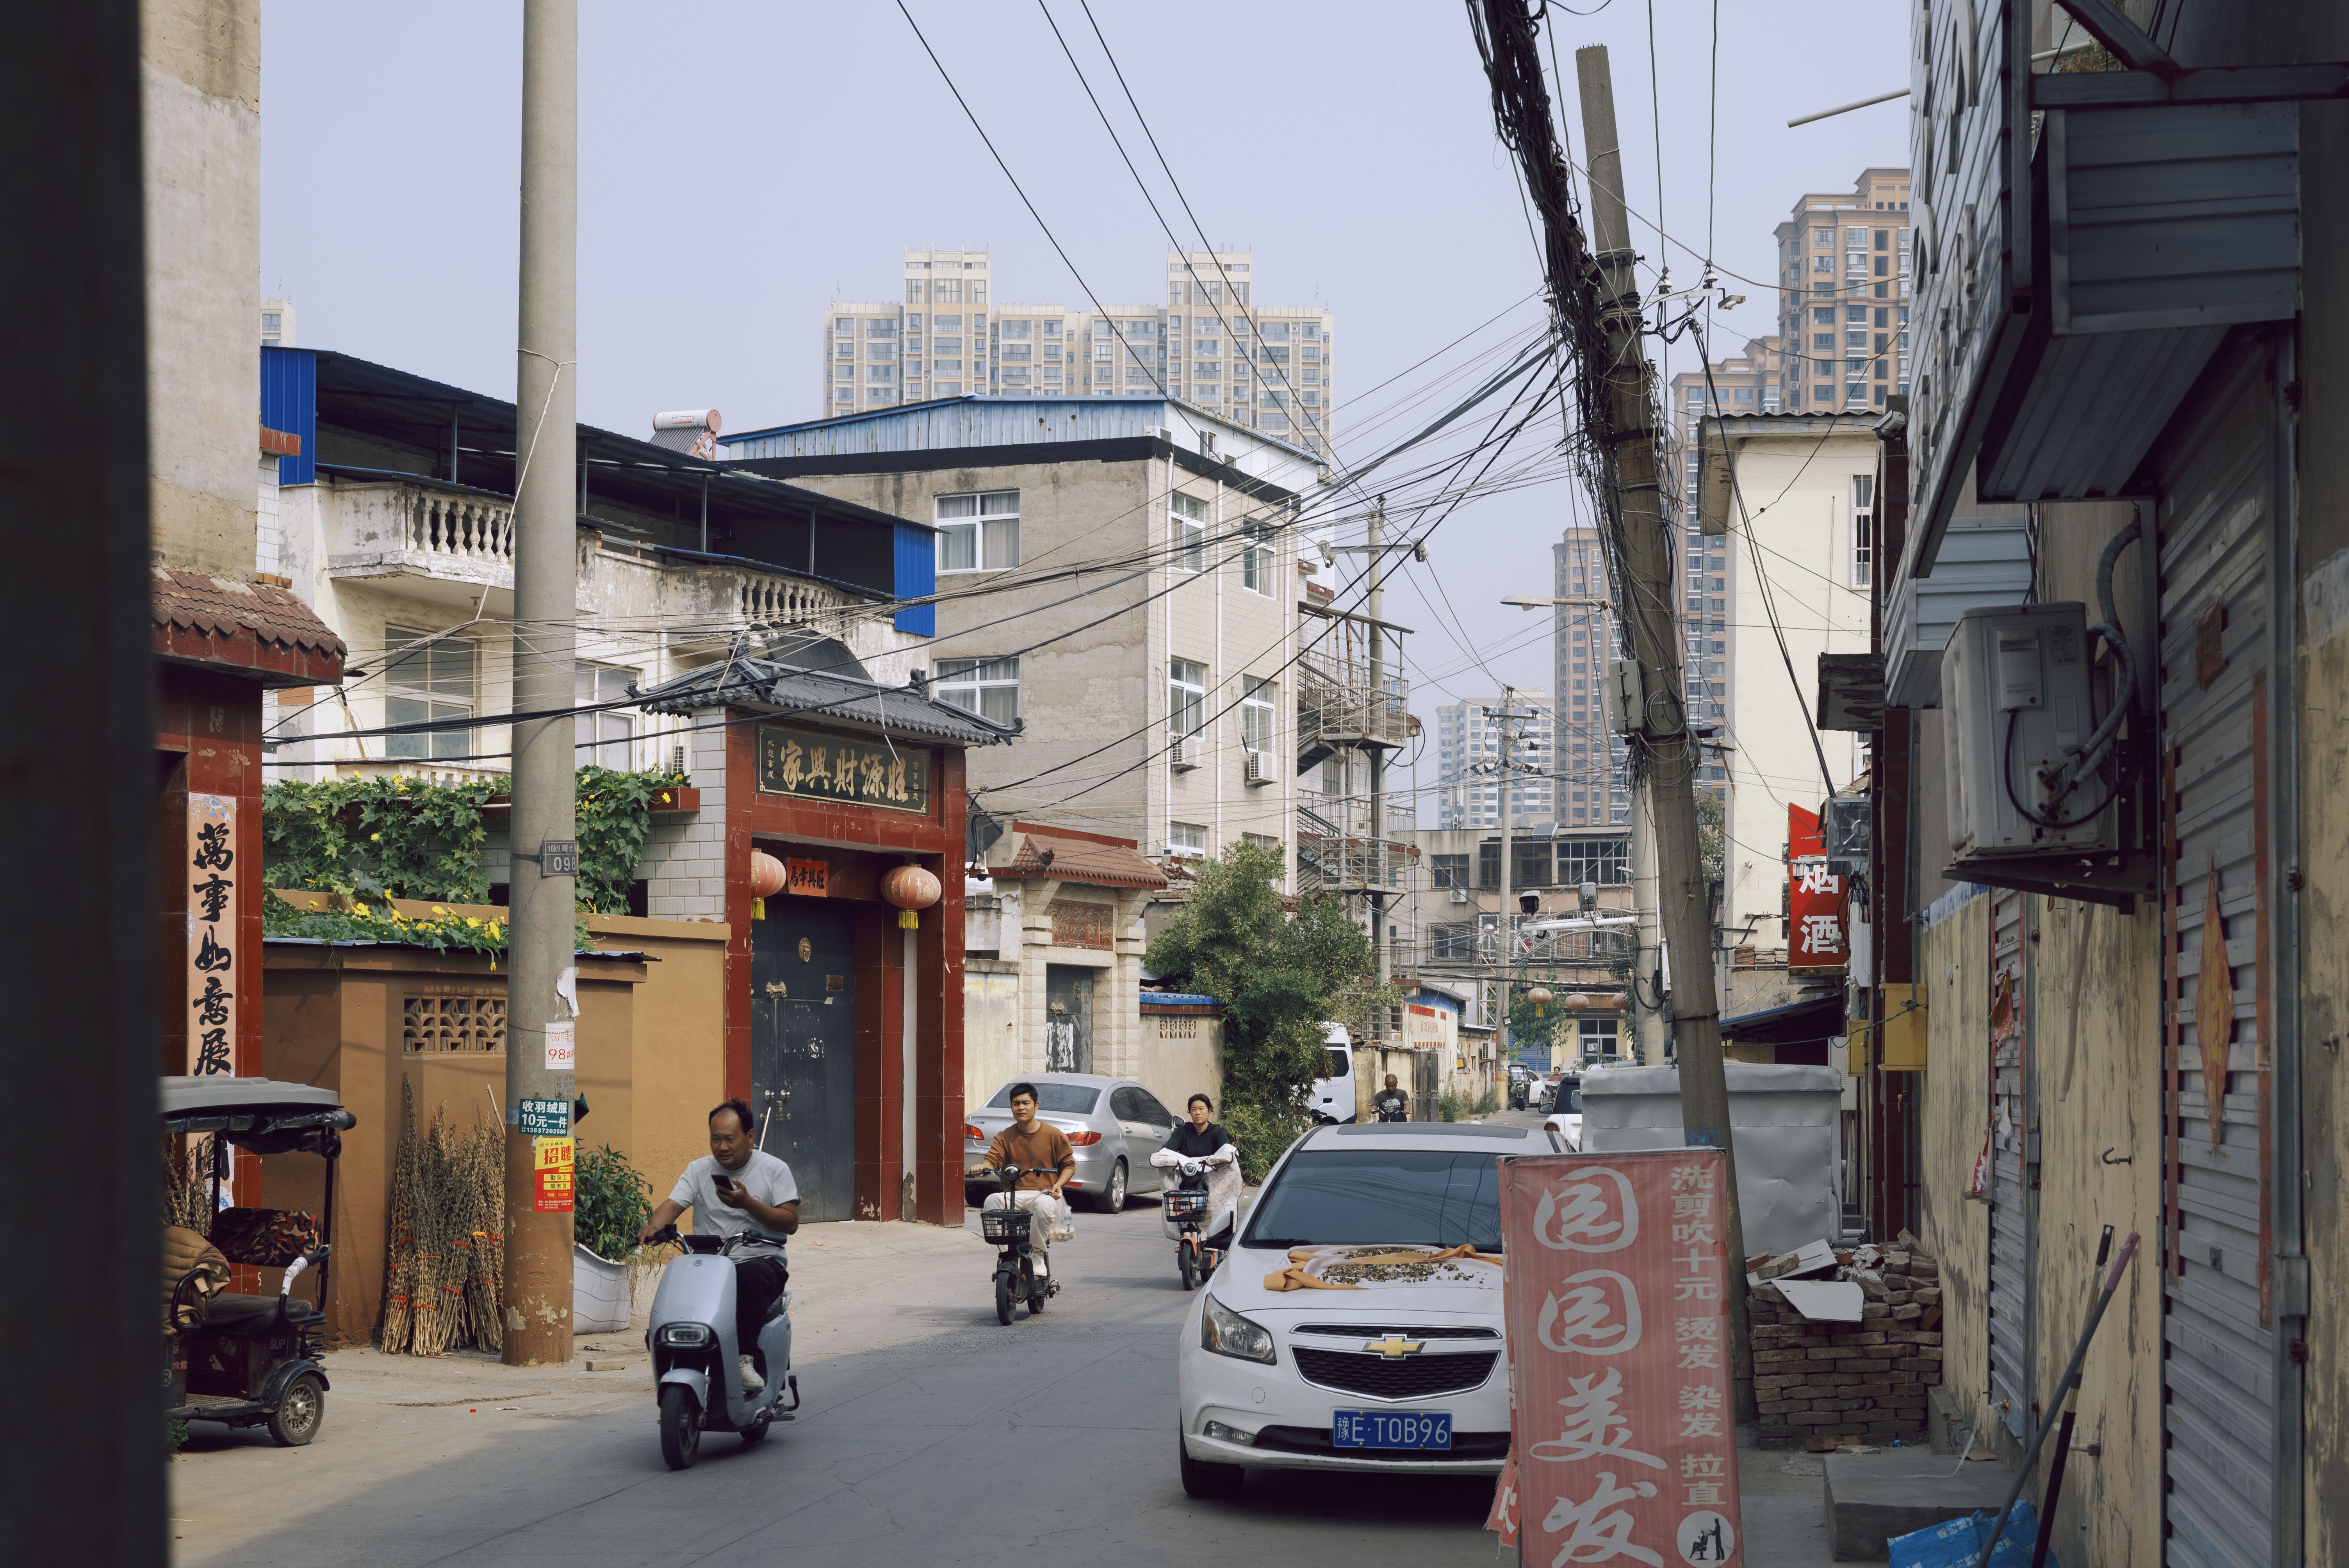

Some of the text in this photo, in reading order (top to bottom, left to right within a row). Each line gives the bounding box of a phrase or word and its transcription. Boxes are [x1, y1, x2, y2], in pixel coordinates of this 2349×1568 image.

[547, 844, 577, 853] 10kV 曙光
[554, 857, 576, 871] 098
[1798, 856, 1839, 954] 烟酒
[522, 1100, 567, 1114] 收羽绒服
[522, 1114, 567, 1128] 10元一件
[544, 1145, 571, 1165] 招聘
[1670, 1165, 1727, 1506] 洗剪吹十元 烫发 染发 拉直
